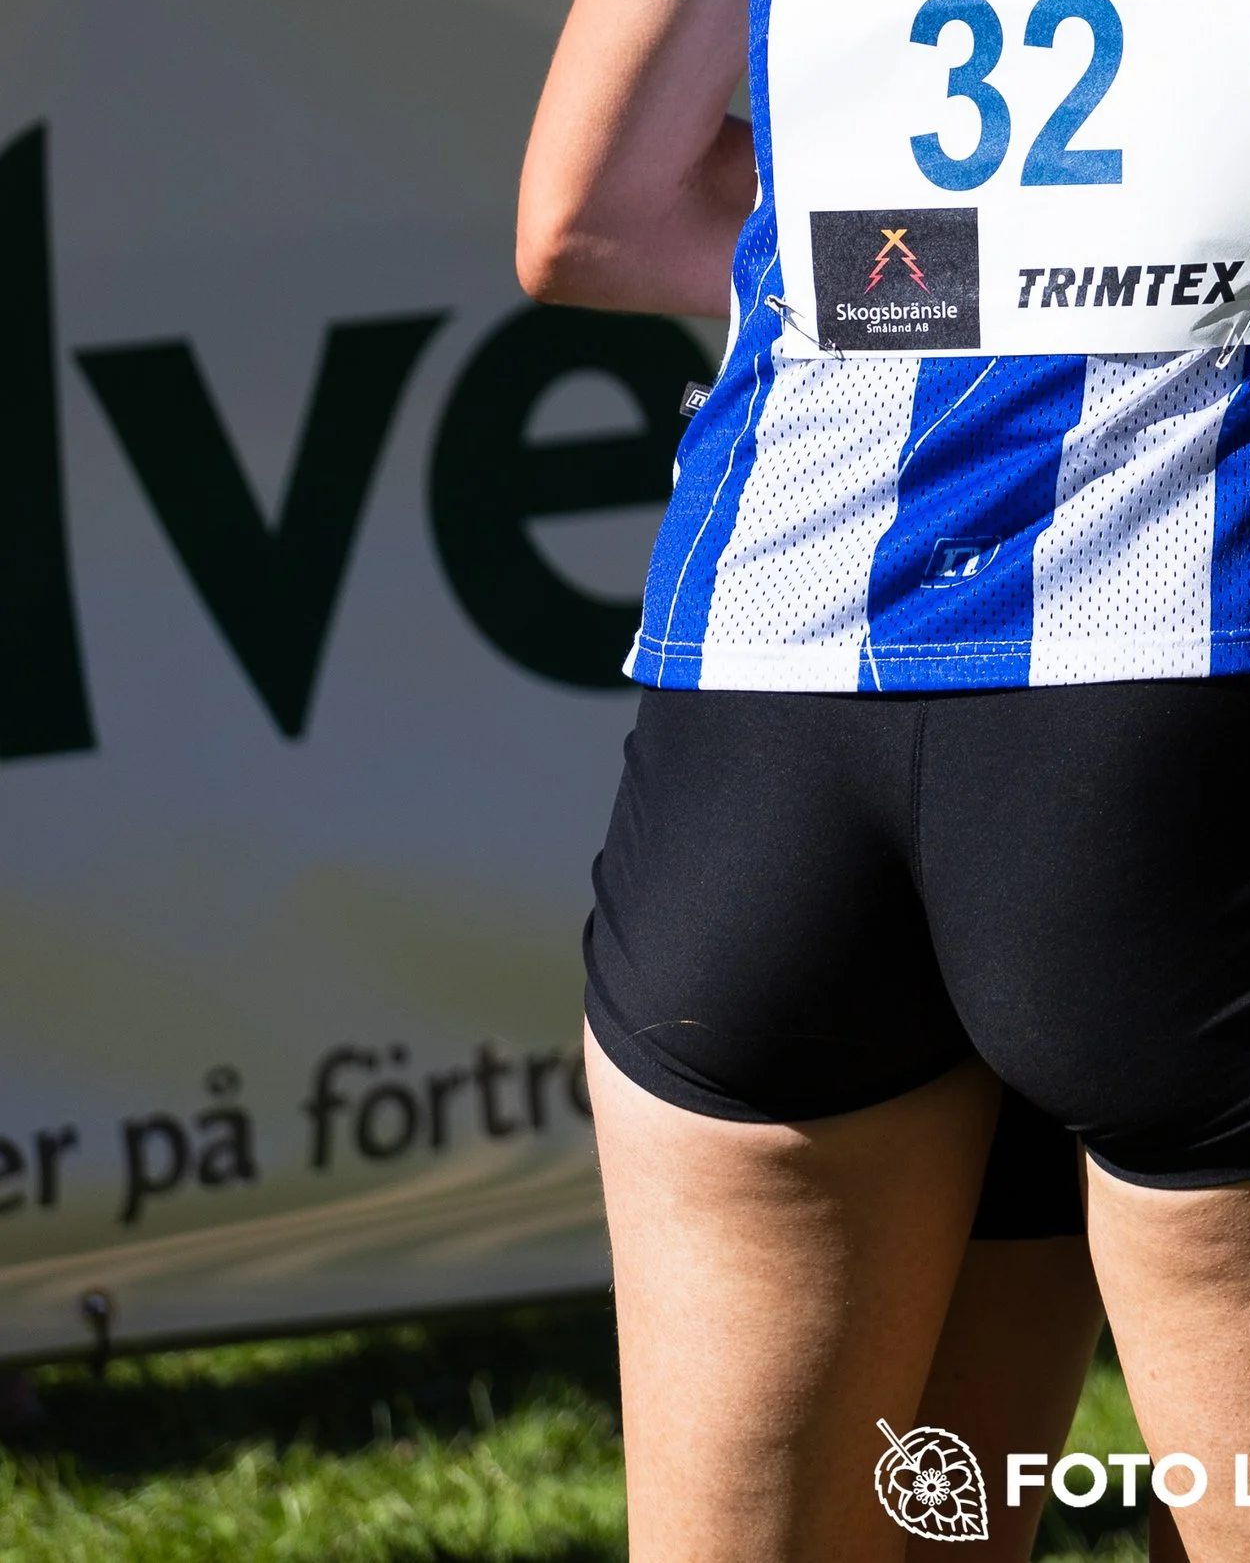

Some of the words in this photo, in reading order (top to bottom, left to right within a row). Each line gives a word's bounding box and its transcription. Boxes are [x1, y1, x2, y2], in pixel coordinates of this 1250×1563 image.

[1017, 261, 1245, 309] TRIMTEX
[836, 301, 958, 324] Skogsbränsle
[866, 322, 911, 334] Småland
[914, 322, 929, 333] AB
[120, 1066, 254, 1225] på
